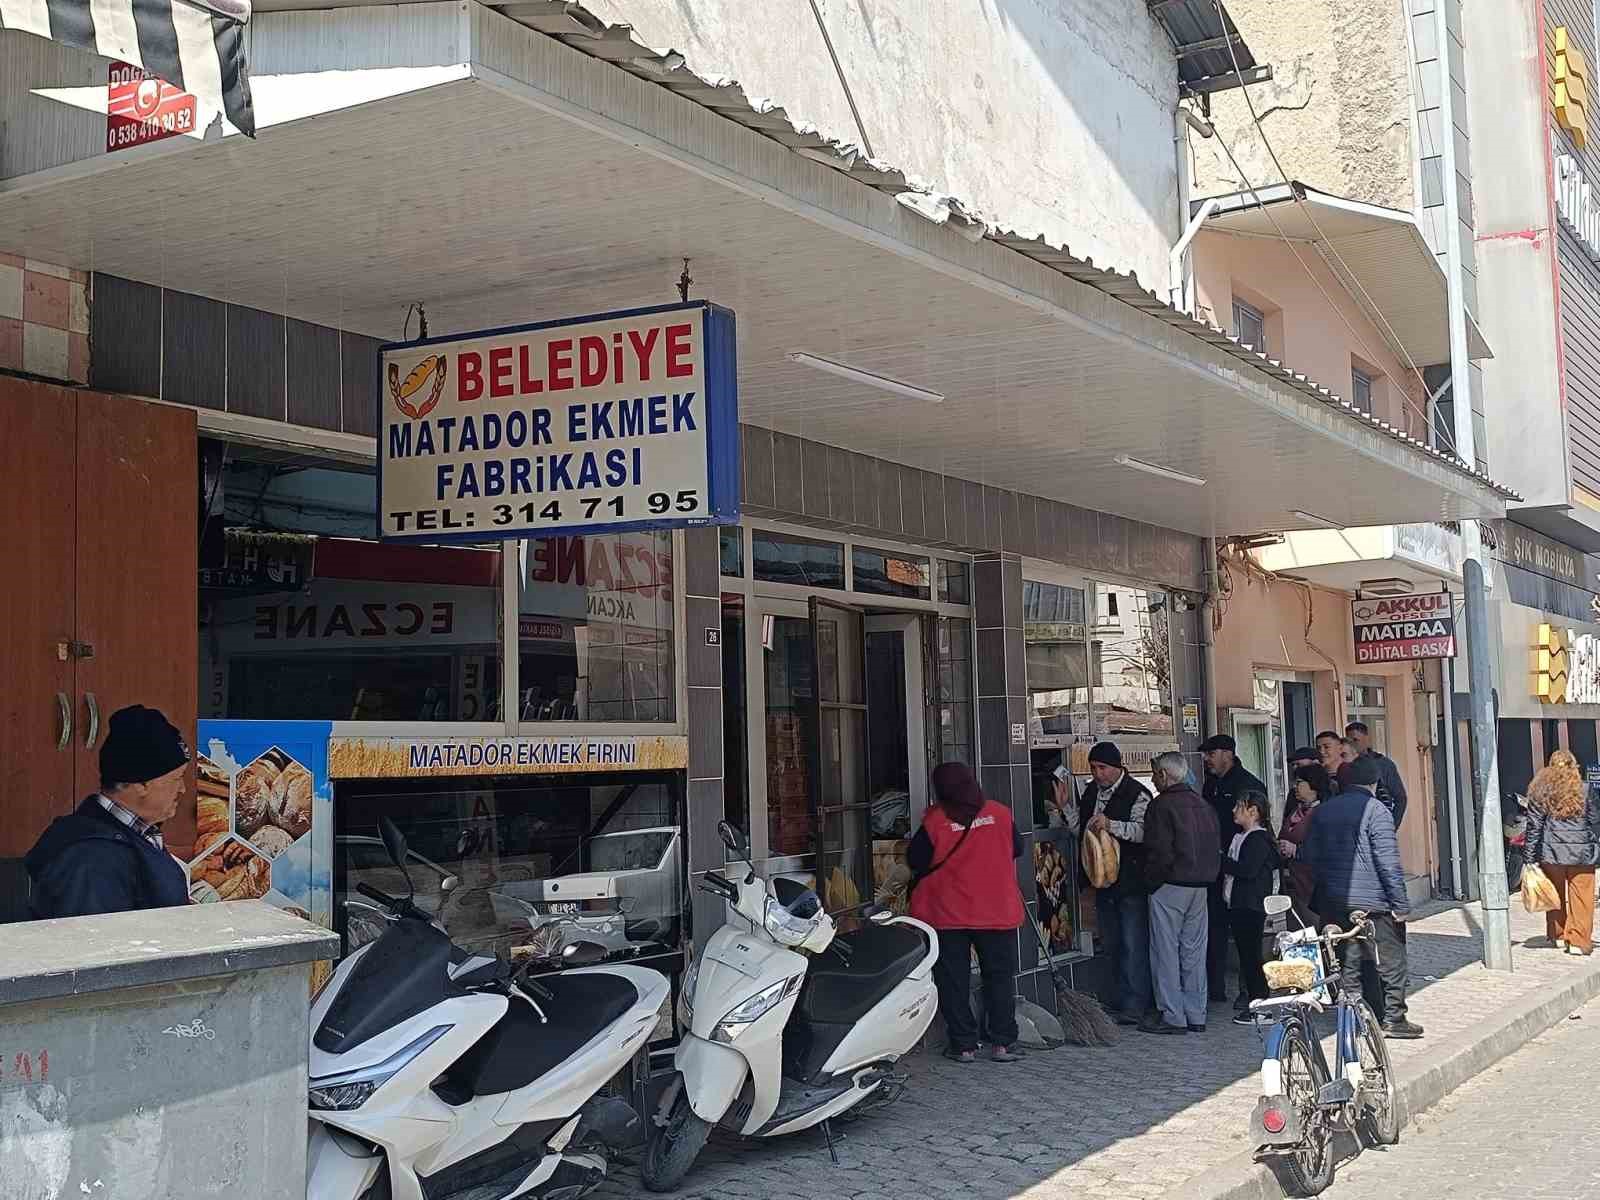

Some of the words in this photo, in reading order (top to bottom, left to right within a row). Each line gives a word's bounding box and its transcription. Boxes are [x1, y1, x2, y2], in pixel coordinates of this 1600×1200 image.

[109, 128, 116, 147] 0
[118, 122, 137, 145] 538
[139, 116, 160, 139] 410
[161, 111, 176, 133] 30
[177, 107, 191, 129] 52
[389, 404, 552, 459] MATADOR
[568, 392, 697, 442] EKMEK
[390, 509, 475, 532] TEL:
[492, 500, 562, 525] 314
[579, 496, 625, 519] 71
[647, 490, 699, 514] 95
[1514, 536, 1532, 564] ŞIK
[1535, 545, 1575, 577] MOBİLYA
[1376, 596, 1448, 616] AKKUL
[1390, 611, 1435, 621] OFSET
[1361, 620, 1447, 642] MATBAA
[1360, 643, 1407, 661] DİJİTAL
[409, 744, 512, 768] MATADOR
[517, 743, 581, 765] EKMEK
[585, 743, 636, 764] FIRINI
